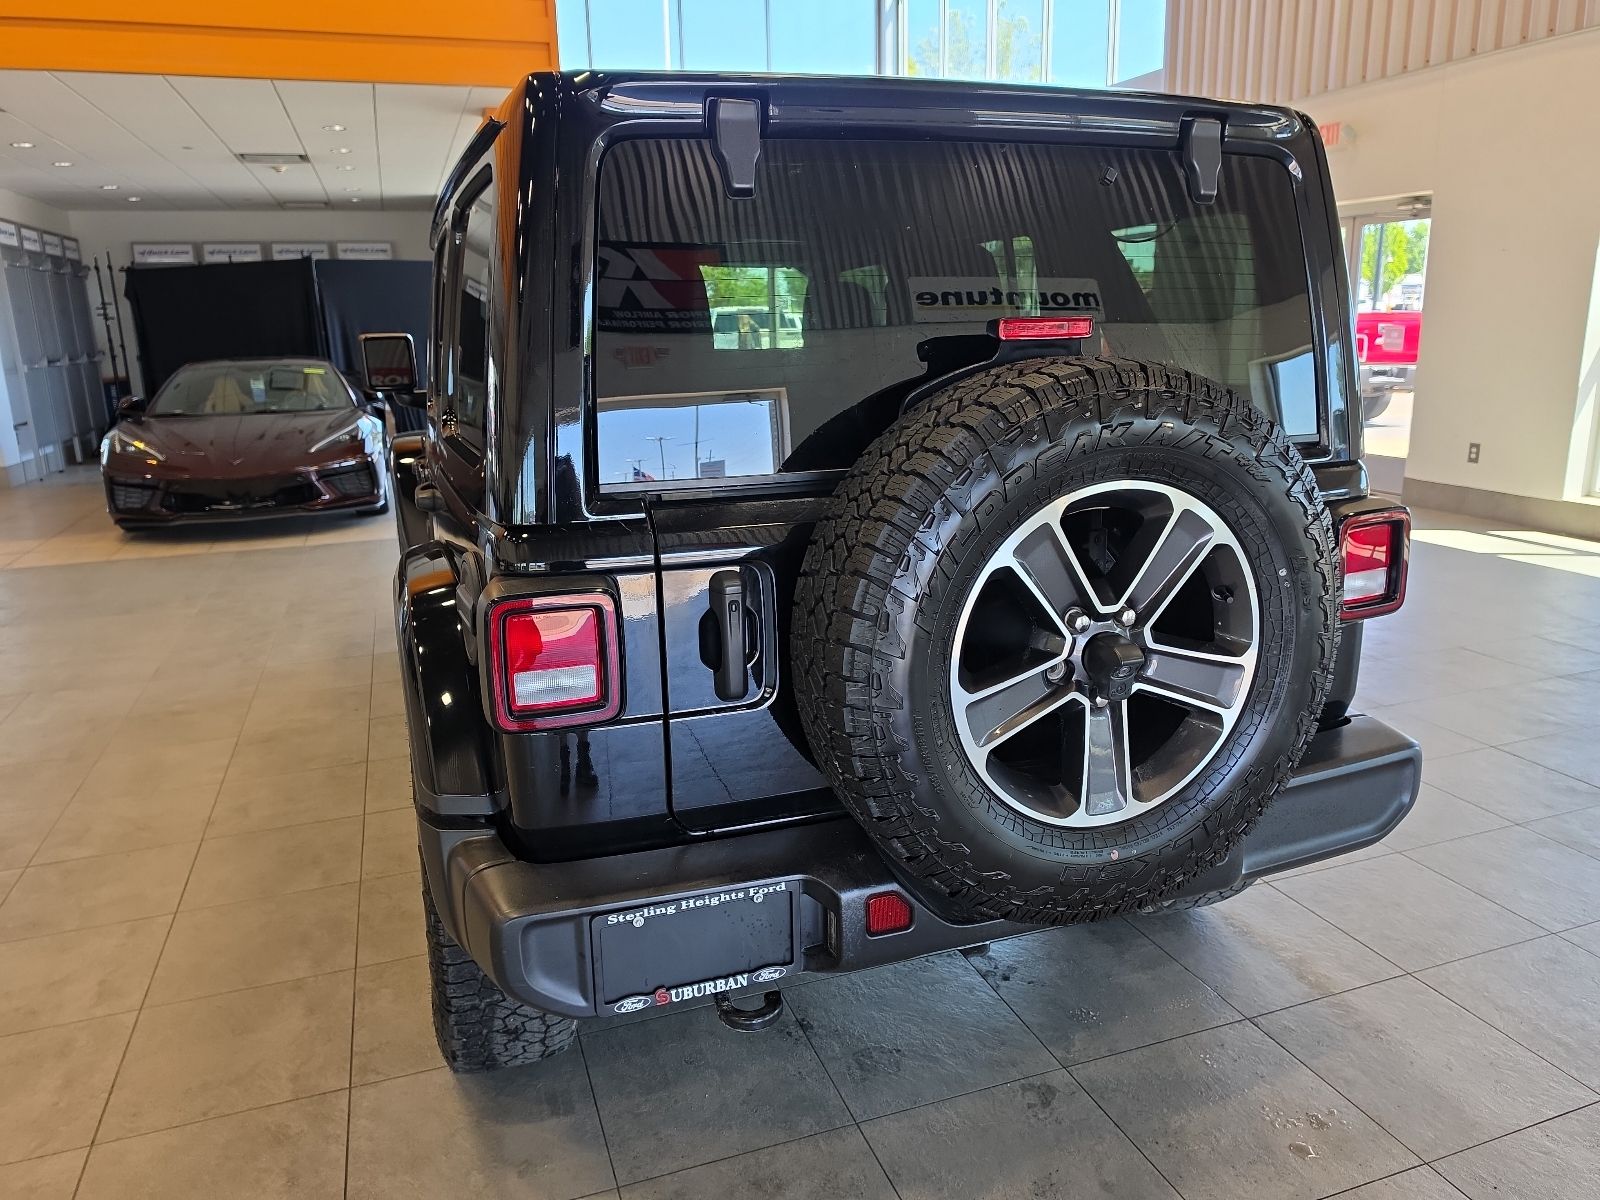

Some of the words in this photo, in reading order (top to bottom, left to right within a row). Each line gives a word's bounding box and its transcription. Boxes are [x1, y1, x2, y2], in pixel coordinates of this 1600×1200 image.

[607, 905, 677, 925] Sterling
[681, 891, 745, 911] Heights
[748, 882, 787, 899] Ford
[618, 998, 648, 1013] Ford
[655, 974, 749, 1006] SUBURBAN
[756, 967, 783, 981] Ford
